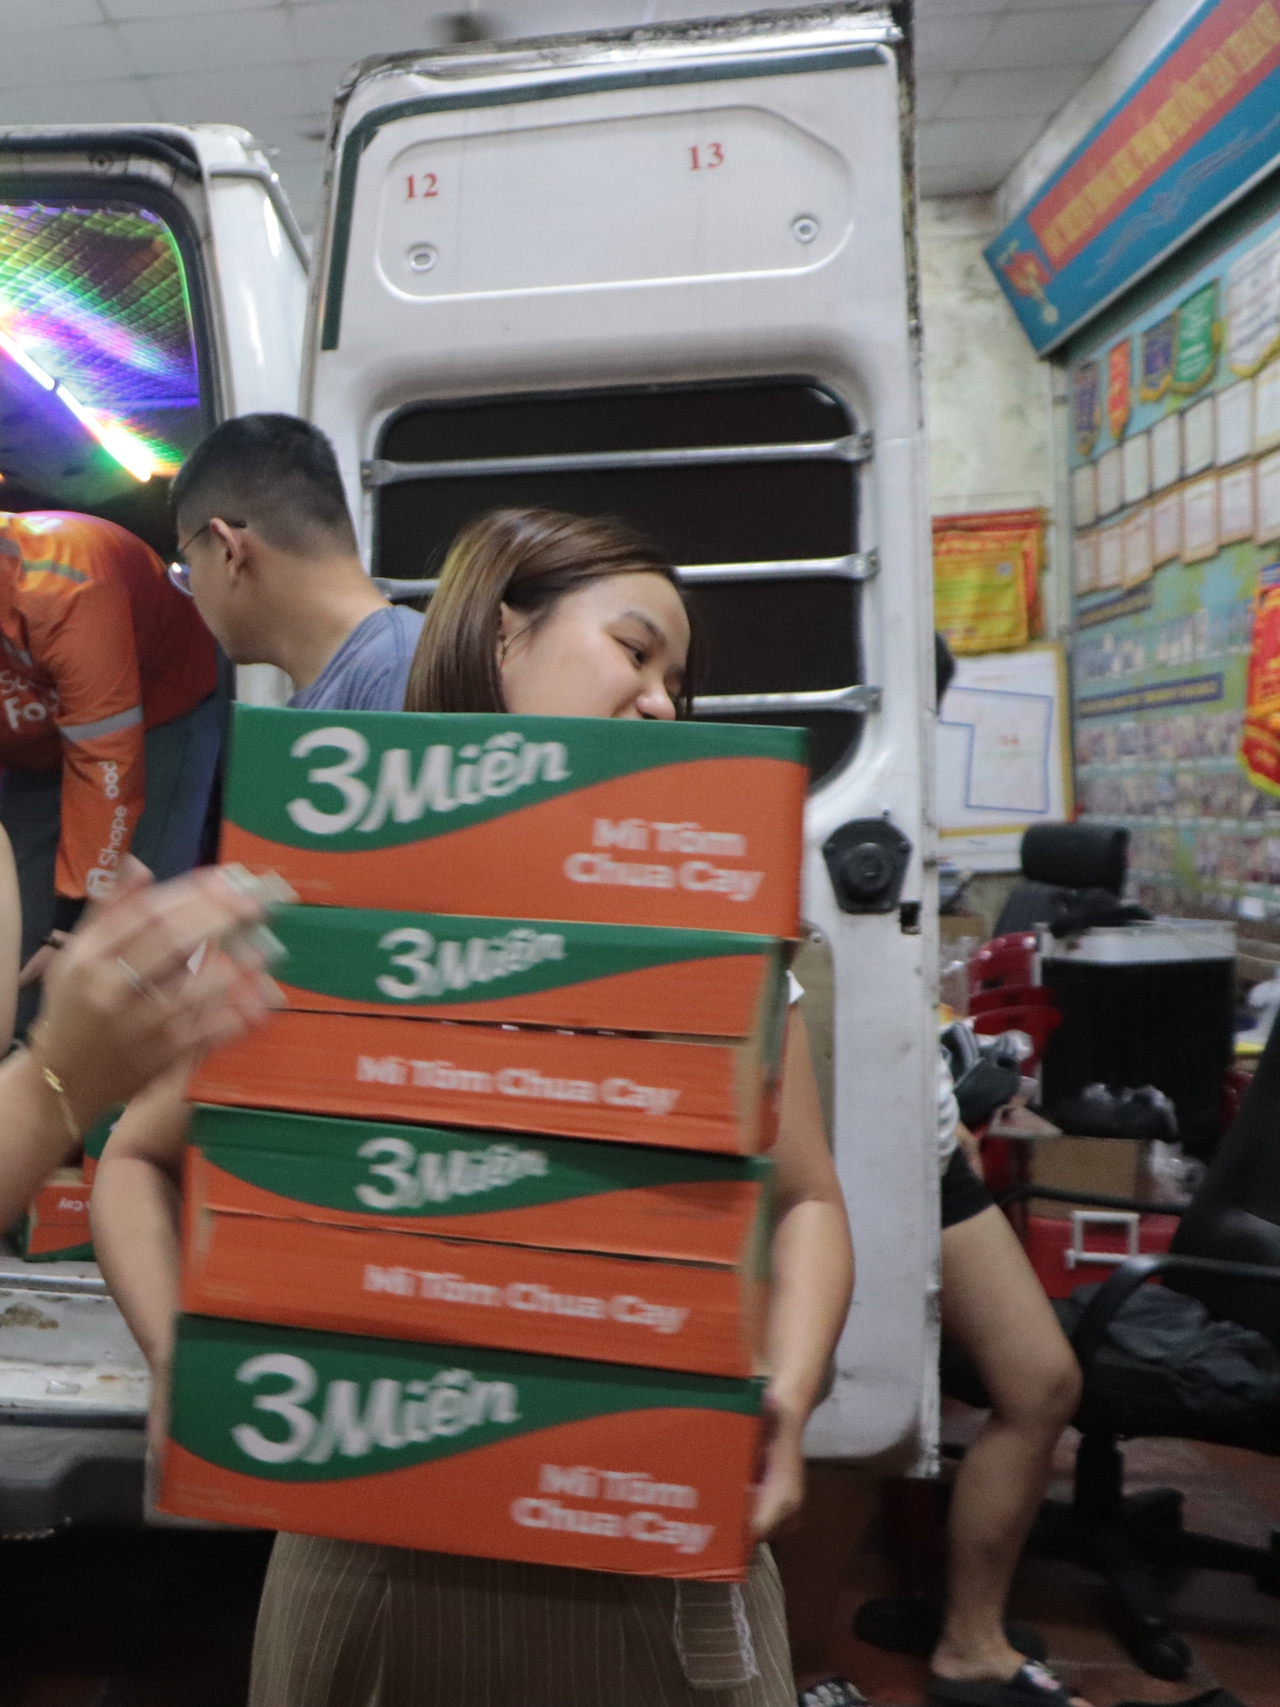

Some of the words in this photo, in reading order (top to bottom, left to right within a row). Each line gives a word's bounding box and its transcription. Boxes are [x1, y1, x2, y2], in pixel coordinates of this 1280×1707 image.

[687, 141, 725, 171] 13
[403, 172, 439, 200] 12
[650, 821, 747, 857] Tôm
[562, 853, 676, 889] Chua
[678, 860, 766, 903] Cay
[495, 1068, 599, 1103] Chua
[600, 1077, 682, 1116] Cay
[503, 1279, 608, 1318] Chua
[608, 1292, 690, 1334] Cay
[509, 1497, 624, 1539] Chua
[624, 1504, 716, 1554] Cay
